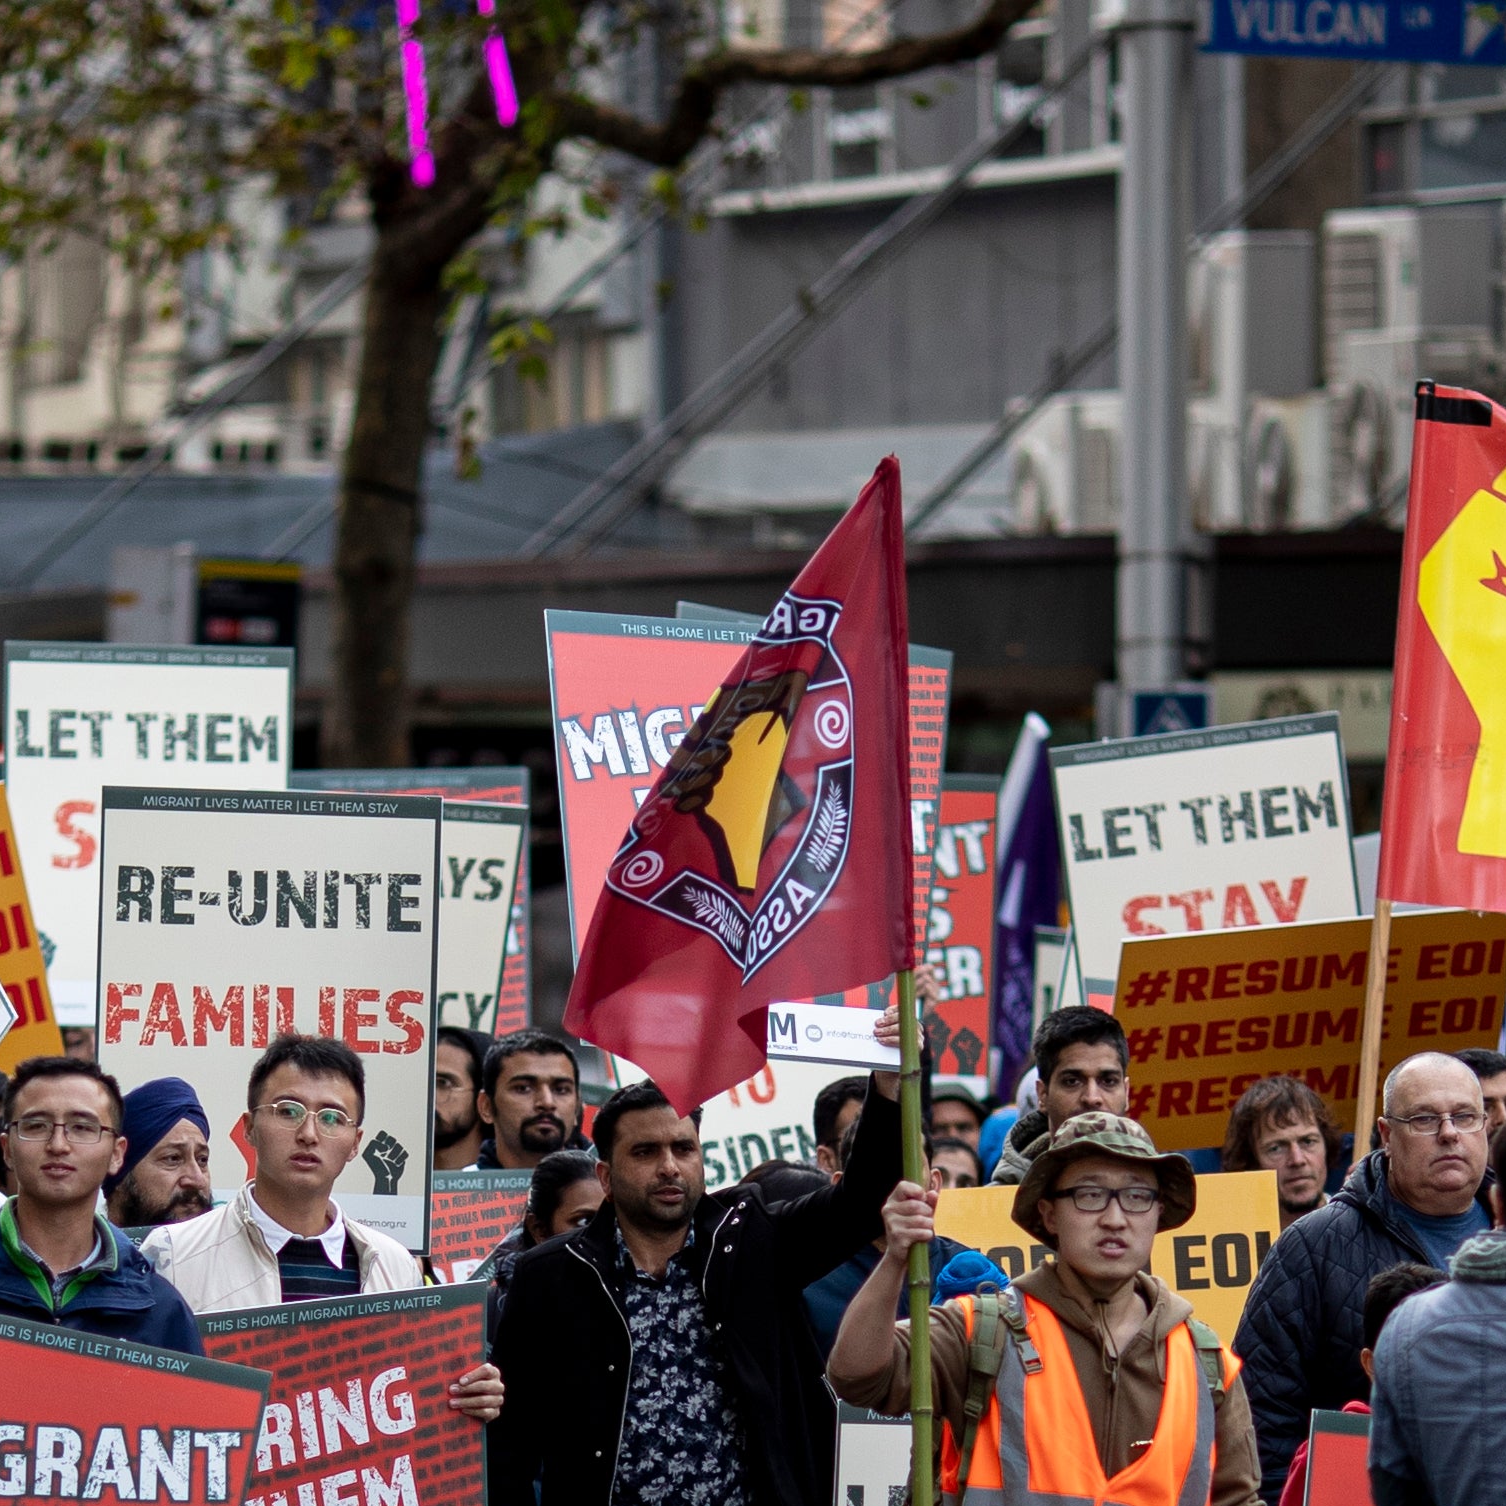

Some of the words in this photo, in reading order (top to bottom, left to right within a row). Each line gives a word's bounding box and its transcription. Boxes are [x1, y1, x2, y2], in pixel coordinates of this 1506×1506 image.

[1230, 0, 1386, 45] VULCAN
[621, 622, 649, 636] THIS
[651, 624, 663, 637] IS
[666, 626, 704, 639] HOME
[714, 630, 735, 642] LET
[15, 709, 112, 760] LET
[126, 711, 279, 763] THEM
[143, 795, 201, 808] MIGRANT
[205, 797, 239, 810] LIVES
[242, 798, 293, 811] MATTER
[303, 800, 324, 812] LET
[328, 801, 364, 814] THEM
[368, 802, 399, 814] STAY
[1069, 803, 1167, 863] LET
[1180, 780, 1339, 846] THEM
[115, 865, 423, 933] RE-UNITE
[1416, 938, 1506, 983] EOI
[104, 981, 426, 1056] FAMILIES
[1406, 996, 1497, 1039] EOI
[447, 1178, 484, 1190] HOME
[494, 1177, 532, 1189] MIGRA
[207, 1320, 233, 1333] THIS
[237, 1318, 247, 1330] IS
[251, 1313, 288, 1328] HOME
[298, 1305, 354, 1322] MIGRANT
[358, 1301, 391, 1315] LIVES
[394, 1295, 441, 1310] MATTER
[19, 1328, 32, 1341] IS
[34, 1332, 77, 1351] HOME
[87, 1342, 110, 1356] LET
[114, 1348, 153, 1366] THEM
[156, 1356, 191, 1373] STAY
[256, 1366, 416, 1473] RING
